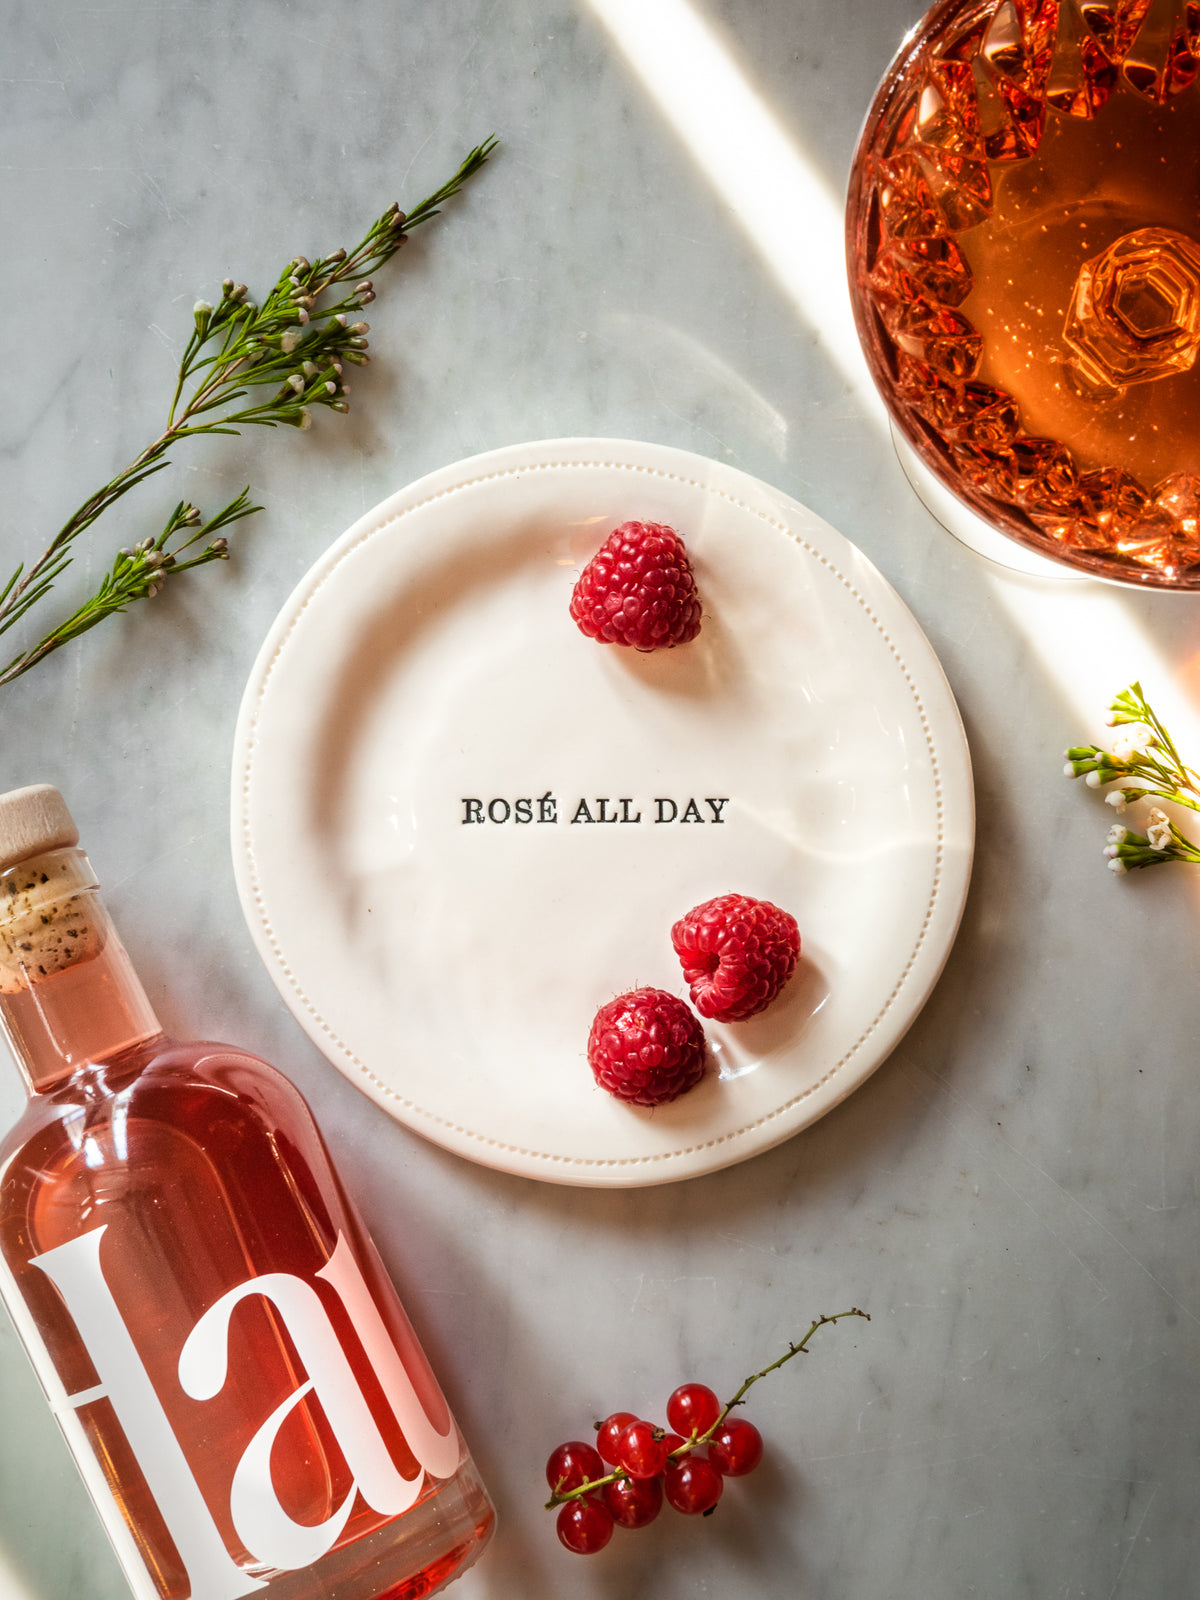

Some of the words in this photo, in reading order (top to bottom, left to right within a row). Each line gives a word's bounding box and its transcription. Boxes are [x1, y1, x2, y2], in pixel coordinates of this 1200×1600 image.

[461, 791, 558, 824] ROSÉ
[570, 798, 642, 824] ALL
[654, 798, 730, 824] DAY
